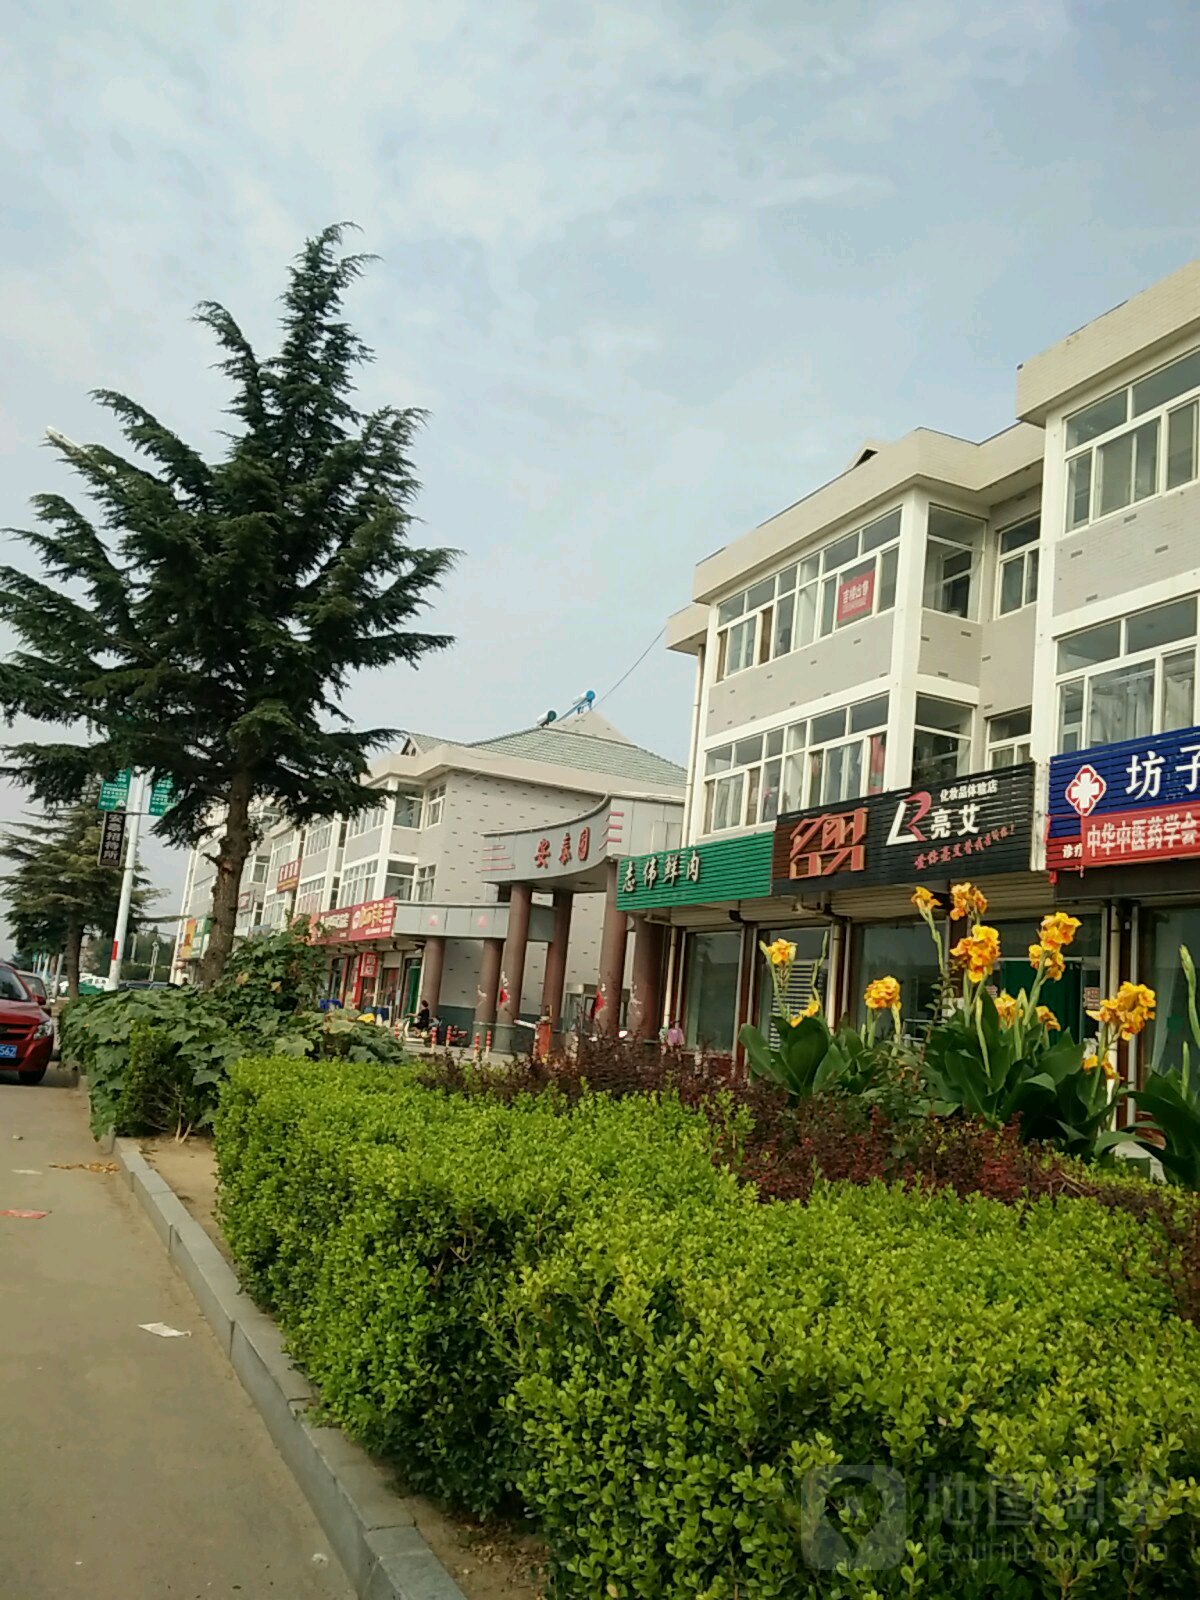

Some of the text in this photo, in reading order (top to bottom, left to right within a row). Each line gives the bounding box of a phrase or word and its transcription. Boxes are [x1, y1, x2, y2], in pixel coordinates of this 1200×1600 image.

[939, 779, 998, 802] 化妆品体验店
[930, 803, 981, 840] 亮艾
[1087, 812, 1197, 857] 中华中医药学会
[622, 849, 700, 892] 志伟鲜肉
